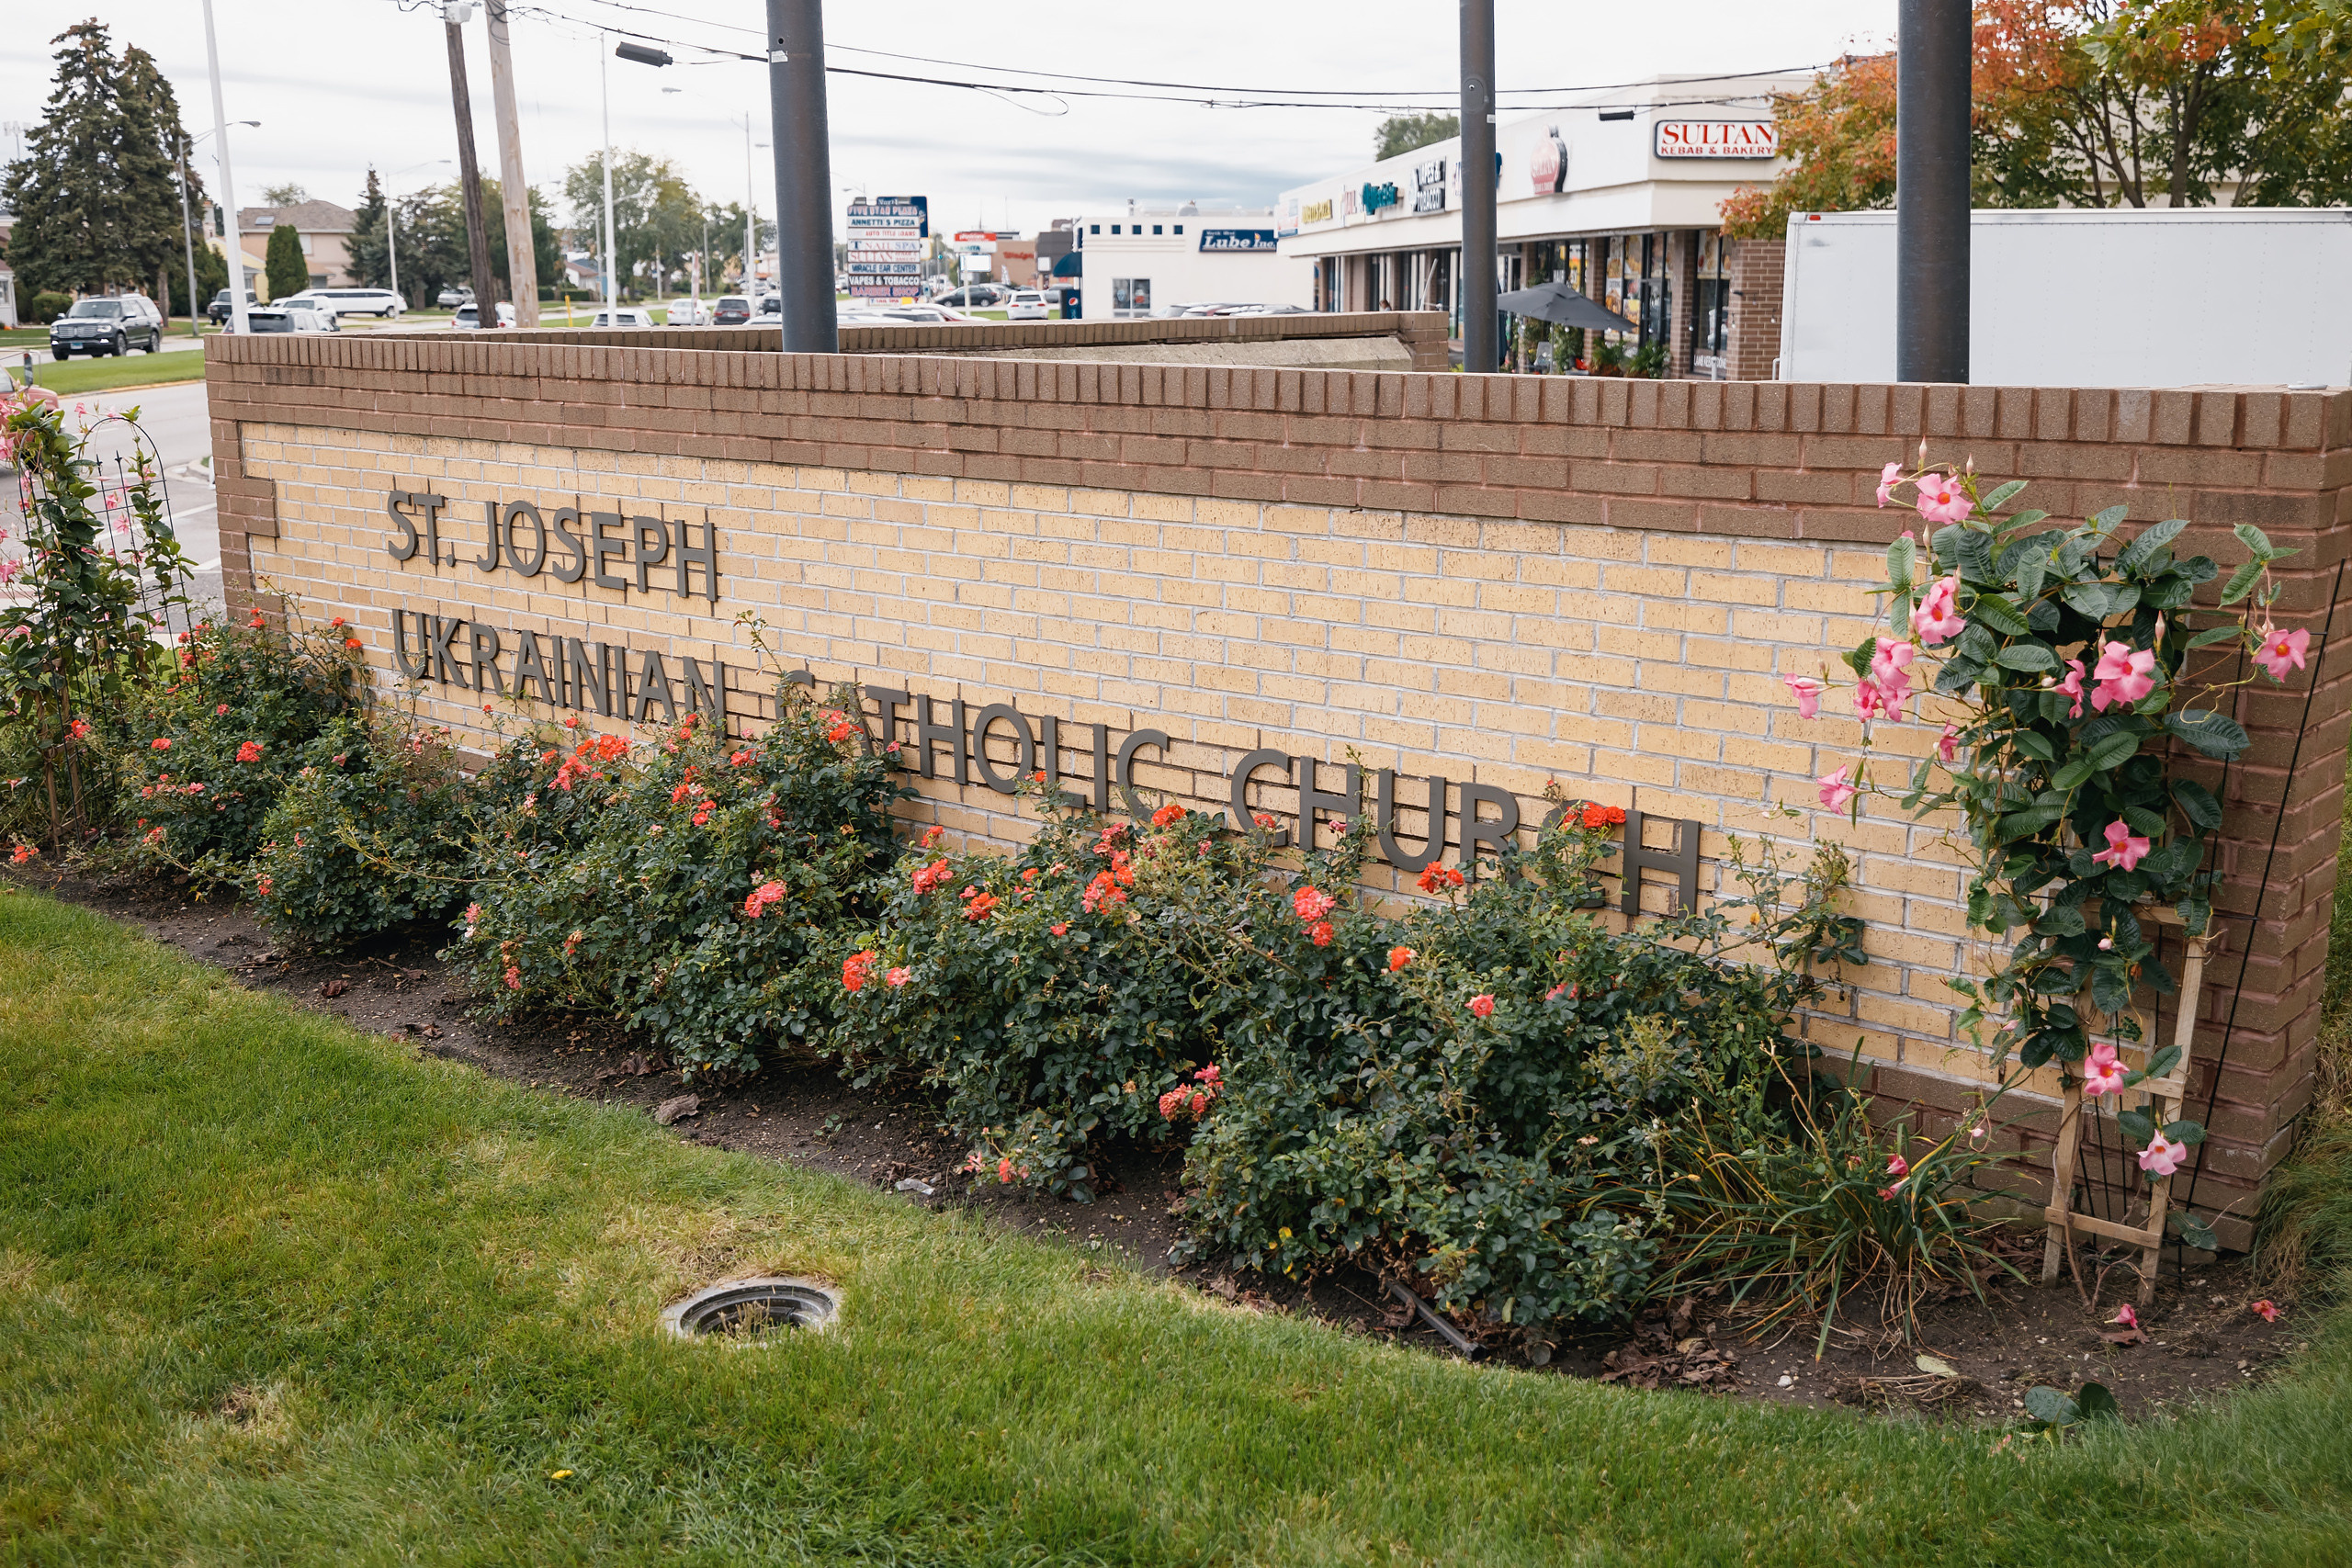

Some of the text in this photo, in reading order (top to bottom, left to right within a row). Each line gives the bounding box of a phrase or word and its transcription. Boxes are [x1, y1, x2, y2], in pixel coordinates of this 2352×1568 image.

[1662, 124, 1773, 144] SULTAN
[1661, 146, 1773, 154] KEBAB & BAKERY
[848, 206, 918, 215] FIVE STAR PLAZA
[1203, 235, 1250, 248] Lube
[851, 252, 893, 262] SULTAN
[852, 265, 876, 273] MIRACLE
[893, 265, 917, 273] CENTER
[849, 276, 919, 286] VAPES & TOBACCO
[851, 287, 919, 297] BARBER SHOP
[388, 490, 718, 602] ST. JOSEPH
[392, 609, 727, 736] UKRAINIAN
